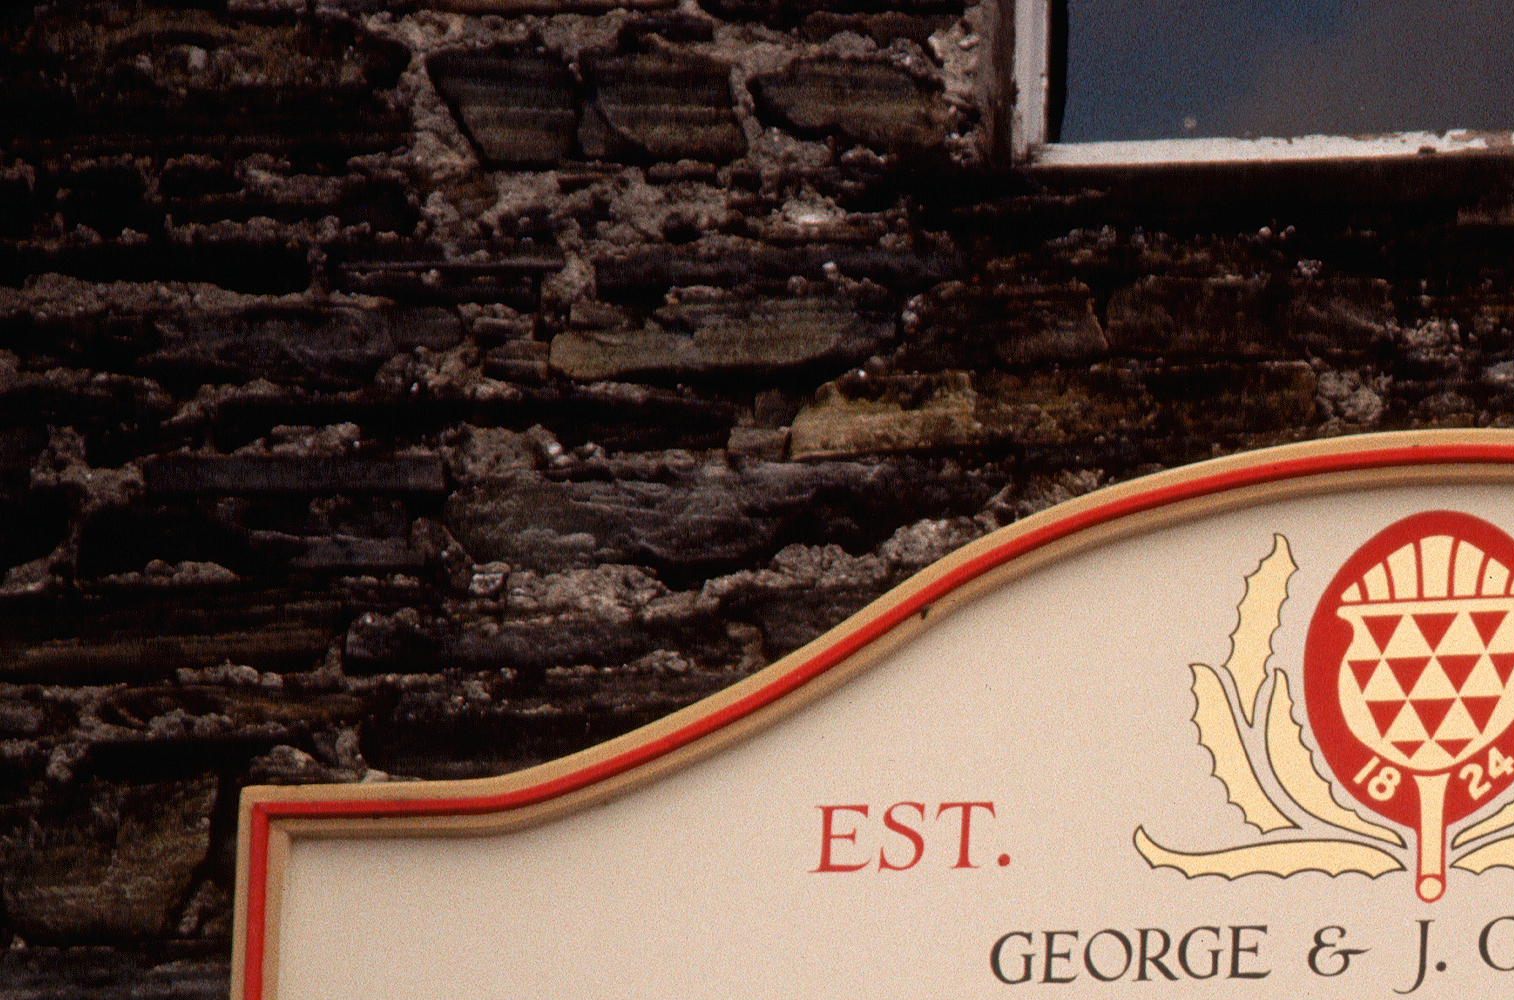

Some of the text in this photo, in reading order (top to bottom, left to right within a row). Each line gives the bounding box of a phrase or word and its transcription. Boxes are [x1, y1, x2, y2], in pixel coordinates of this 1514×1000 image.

[1353, 746, 1514, 801] 18 24
[814, 802, 1010, 872] EST.
[990, 925, 1270, 984] GEORGE
[1308, 926, 1367, 976] &
[1395, 920, 1446, 994] J.
